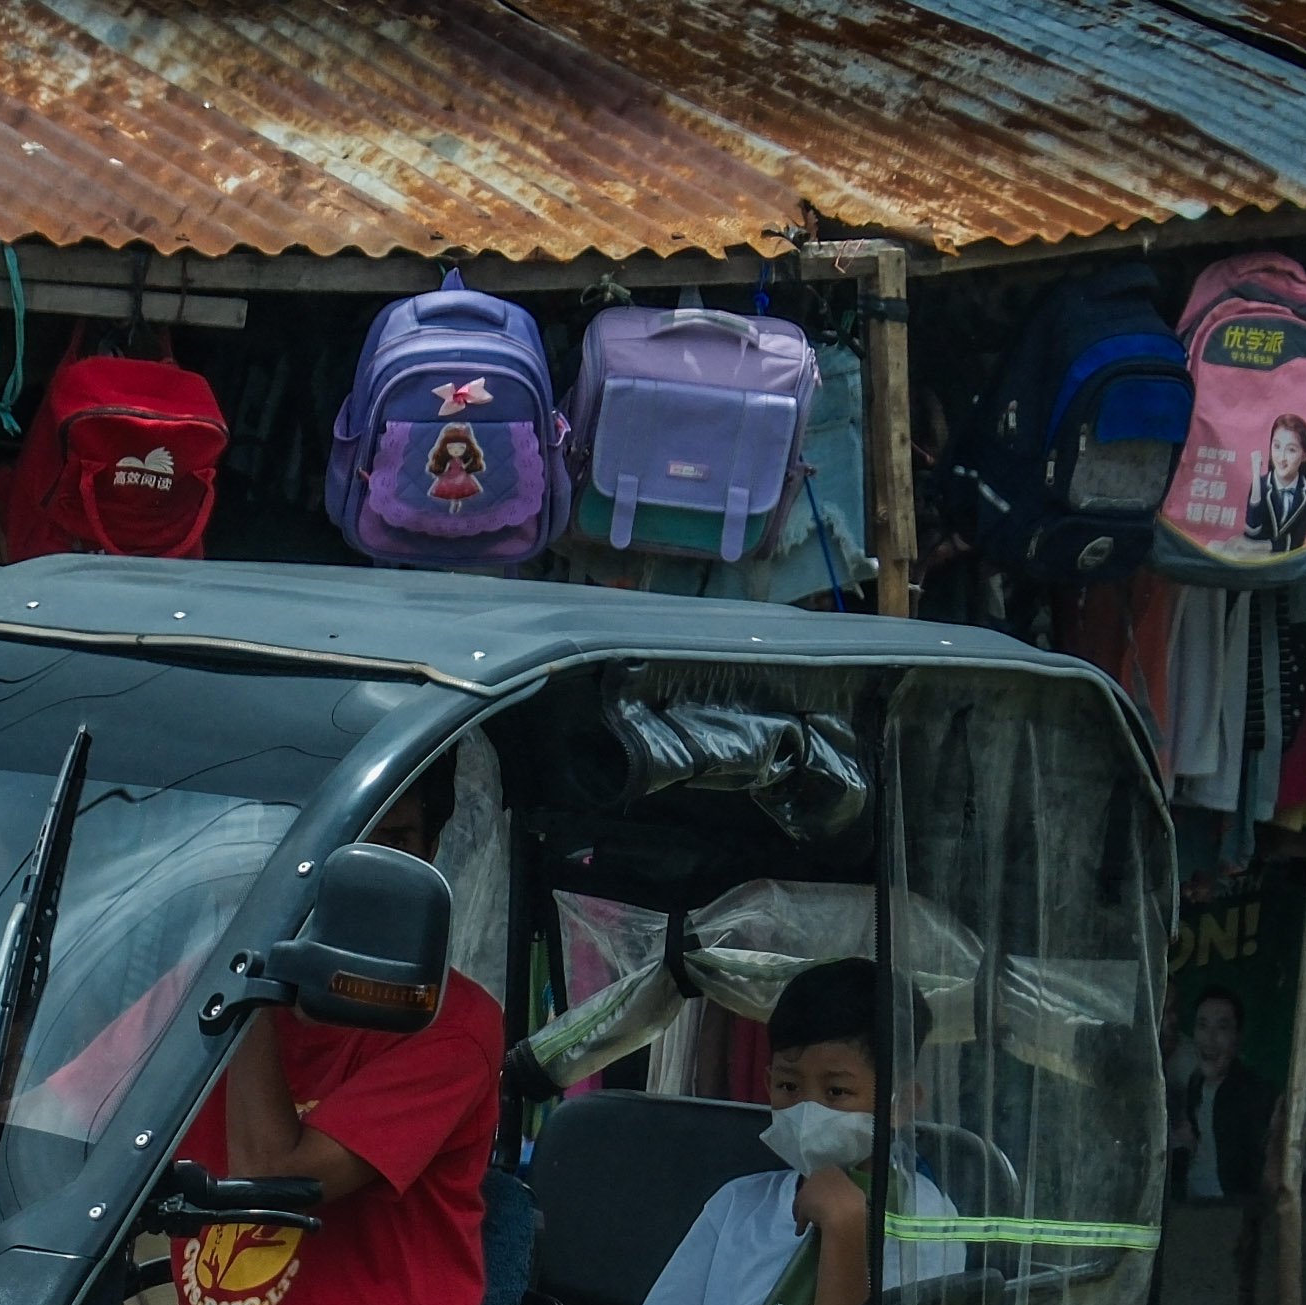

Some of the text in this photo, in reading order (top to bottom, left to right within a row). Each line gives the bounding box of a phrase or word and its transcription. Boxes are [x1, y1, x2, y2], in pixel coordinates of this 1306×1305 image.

[1223, 325, 1285, 354] 优学派
[113, 470, 174, 492] 高效阅读
